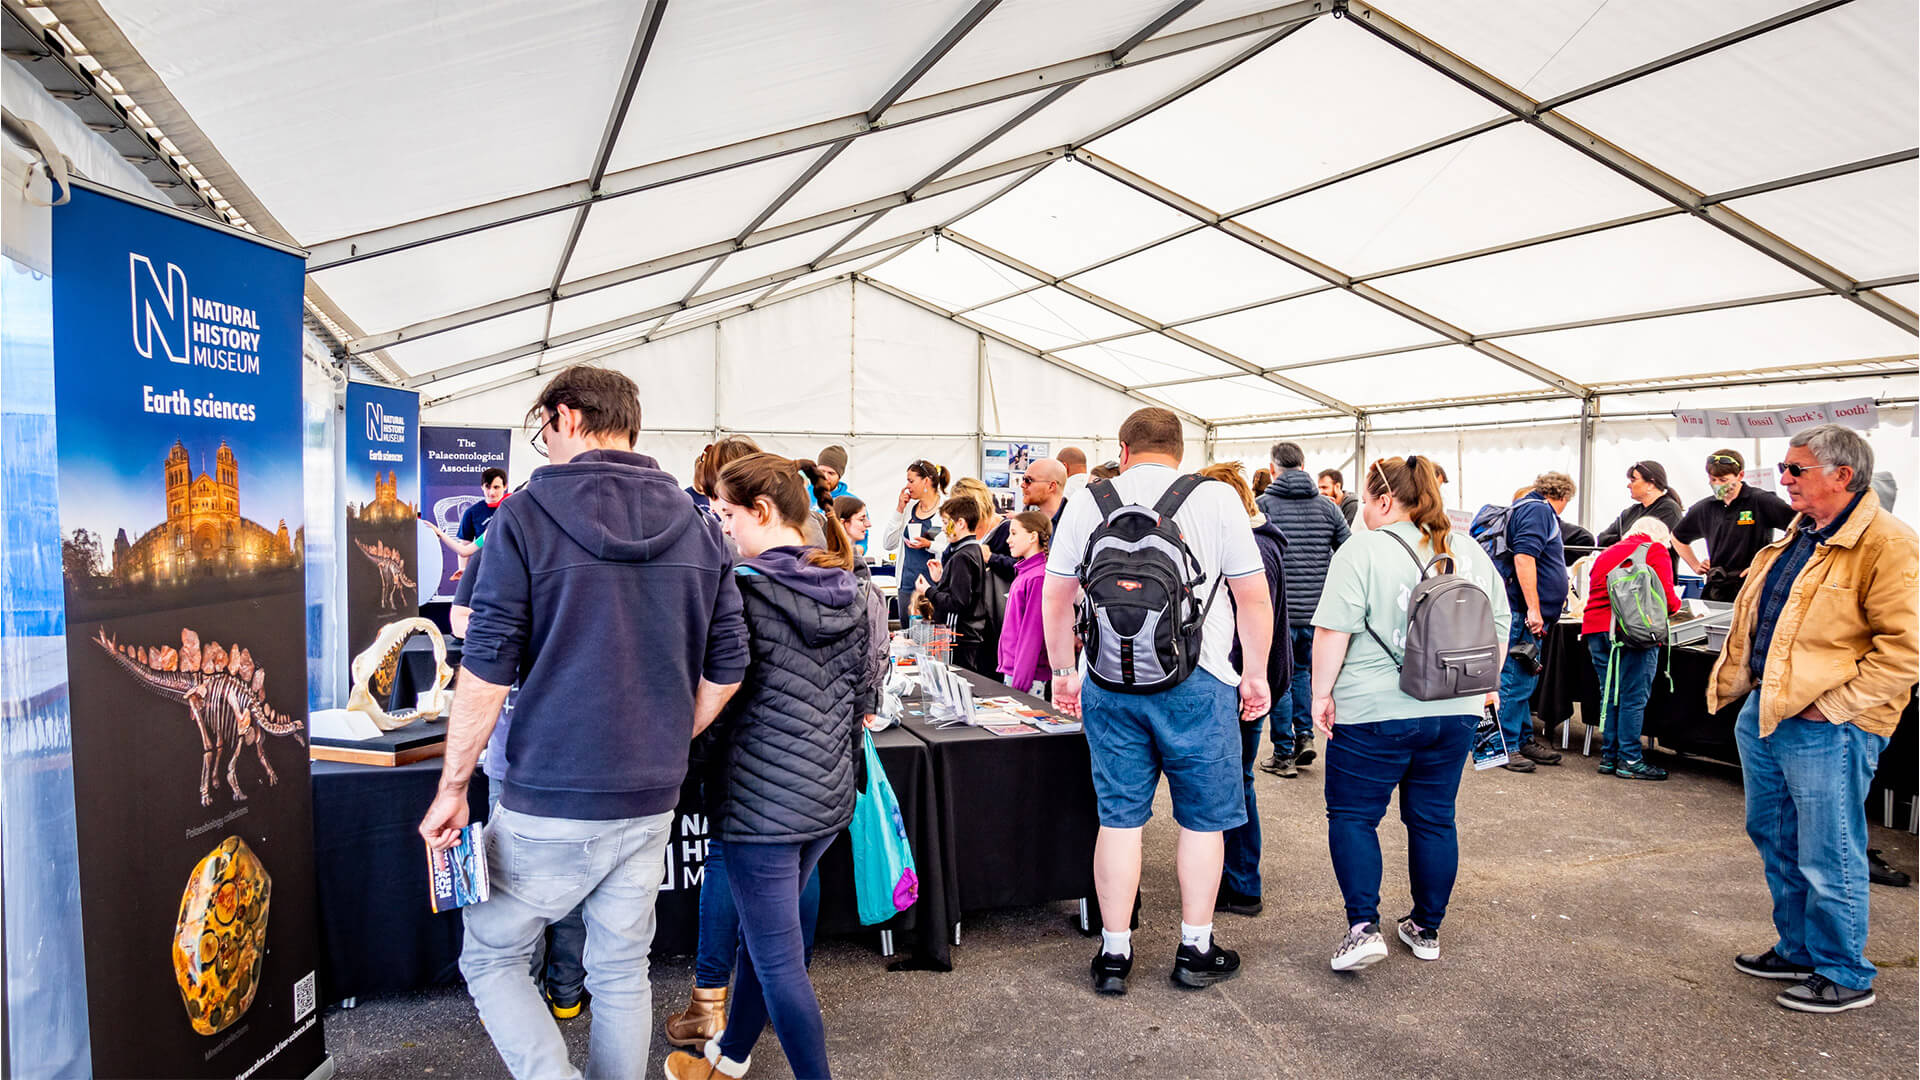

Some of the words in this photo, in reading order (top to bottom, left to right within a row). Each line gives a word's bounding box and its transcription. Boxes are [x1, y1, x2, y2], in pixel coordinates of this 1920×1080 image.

[192, 296, 260, 330] NATURAL
[193, 321, 260, 352] HISTORY
[194, 345, 260, 375] MUSEUM
[143, 385, 190, 416] Earth
[193, 392, 256, 422] sciences
[1715, 417, 1731, 426] real
[1747, 416, 1774, 427] fossil
[1835, 404, 1869, 418] tooth!
[457, 438, 476, 448] The
[428, 451, 504, 462] Palaeontological
[440, 463, 491, 473] Associatio
